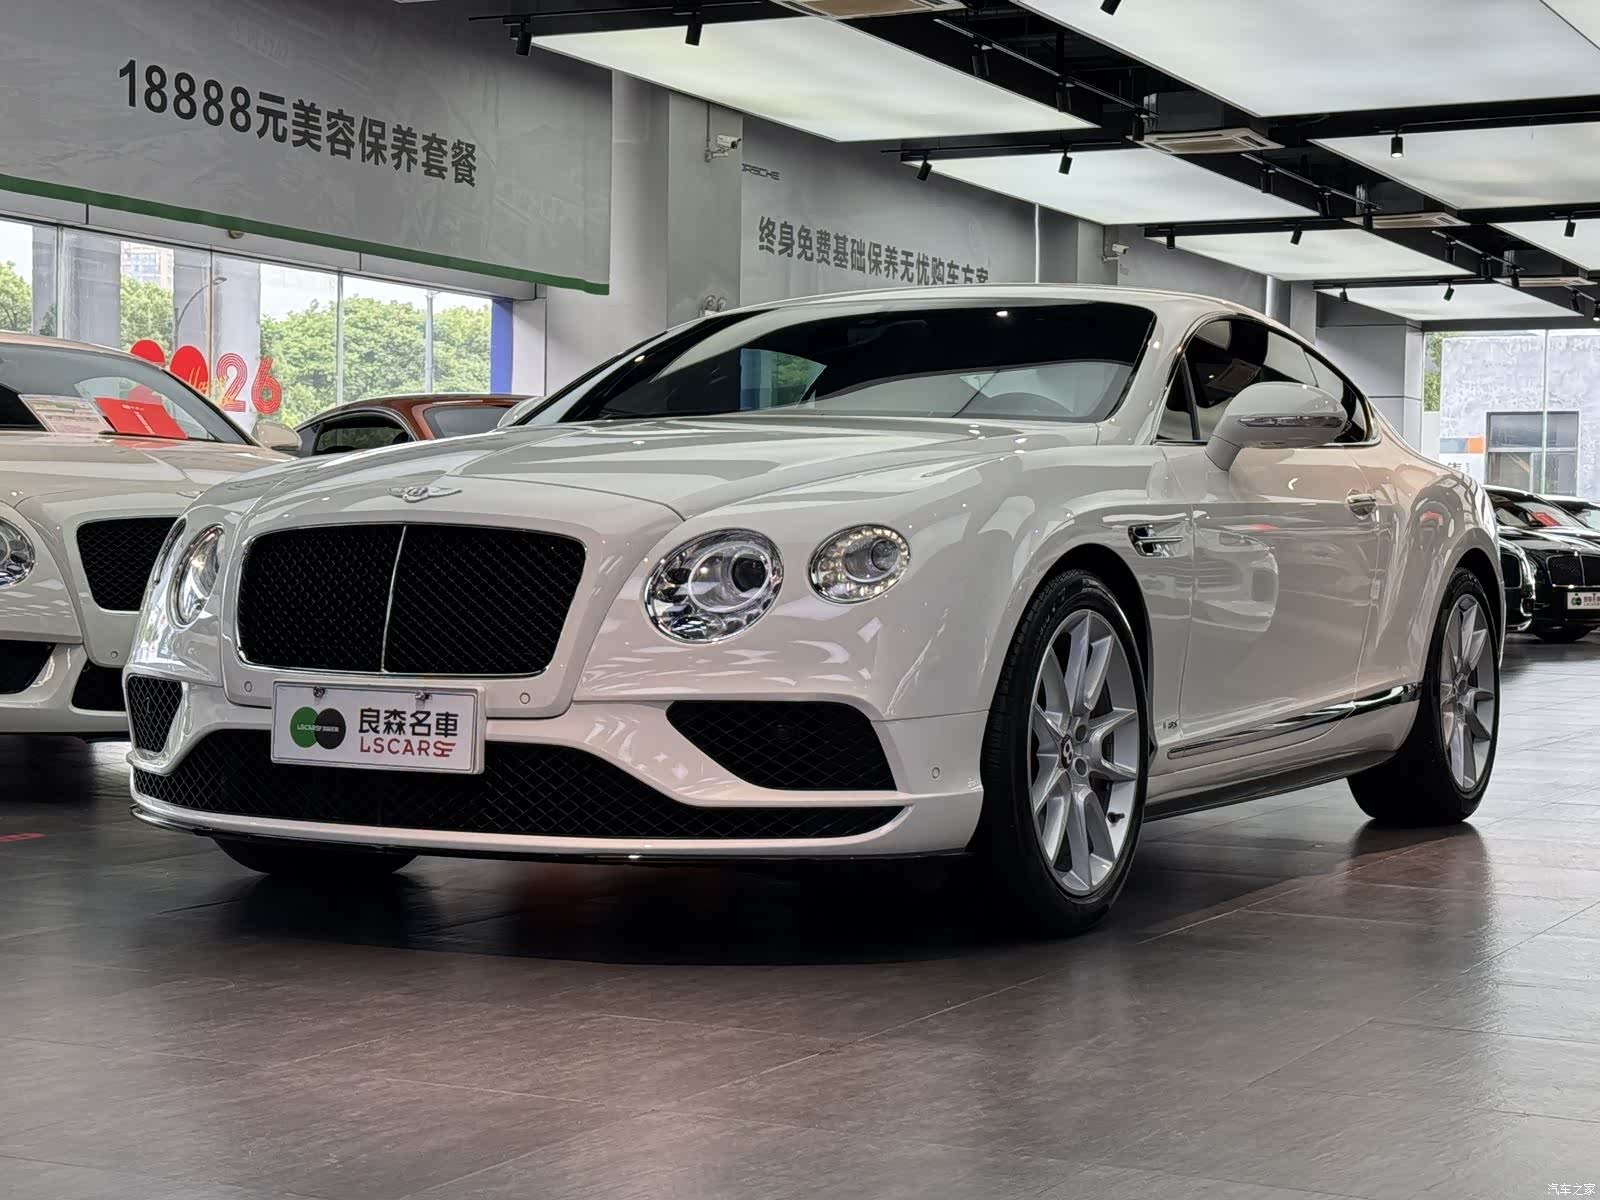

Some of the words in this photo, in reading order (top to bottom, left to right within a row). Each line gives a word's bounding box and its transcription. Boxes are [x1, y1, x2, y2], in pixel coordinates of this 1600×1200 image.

[119, 59, 477, 187] 18888元美容保养套餐
[358, 707, 459, 738] 良森名車
